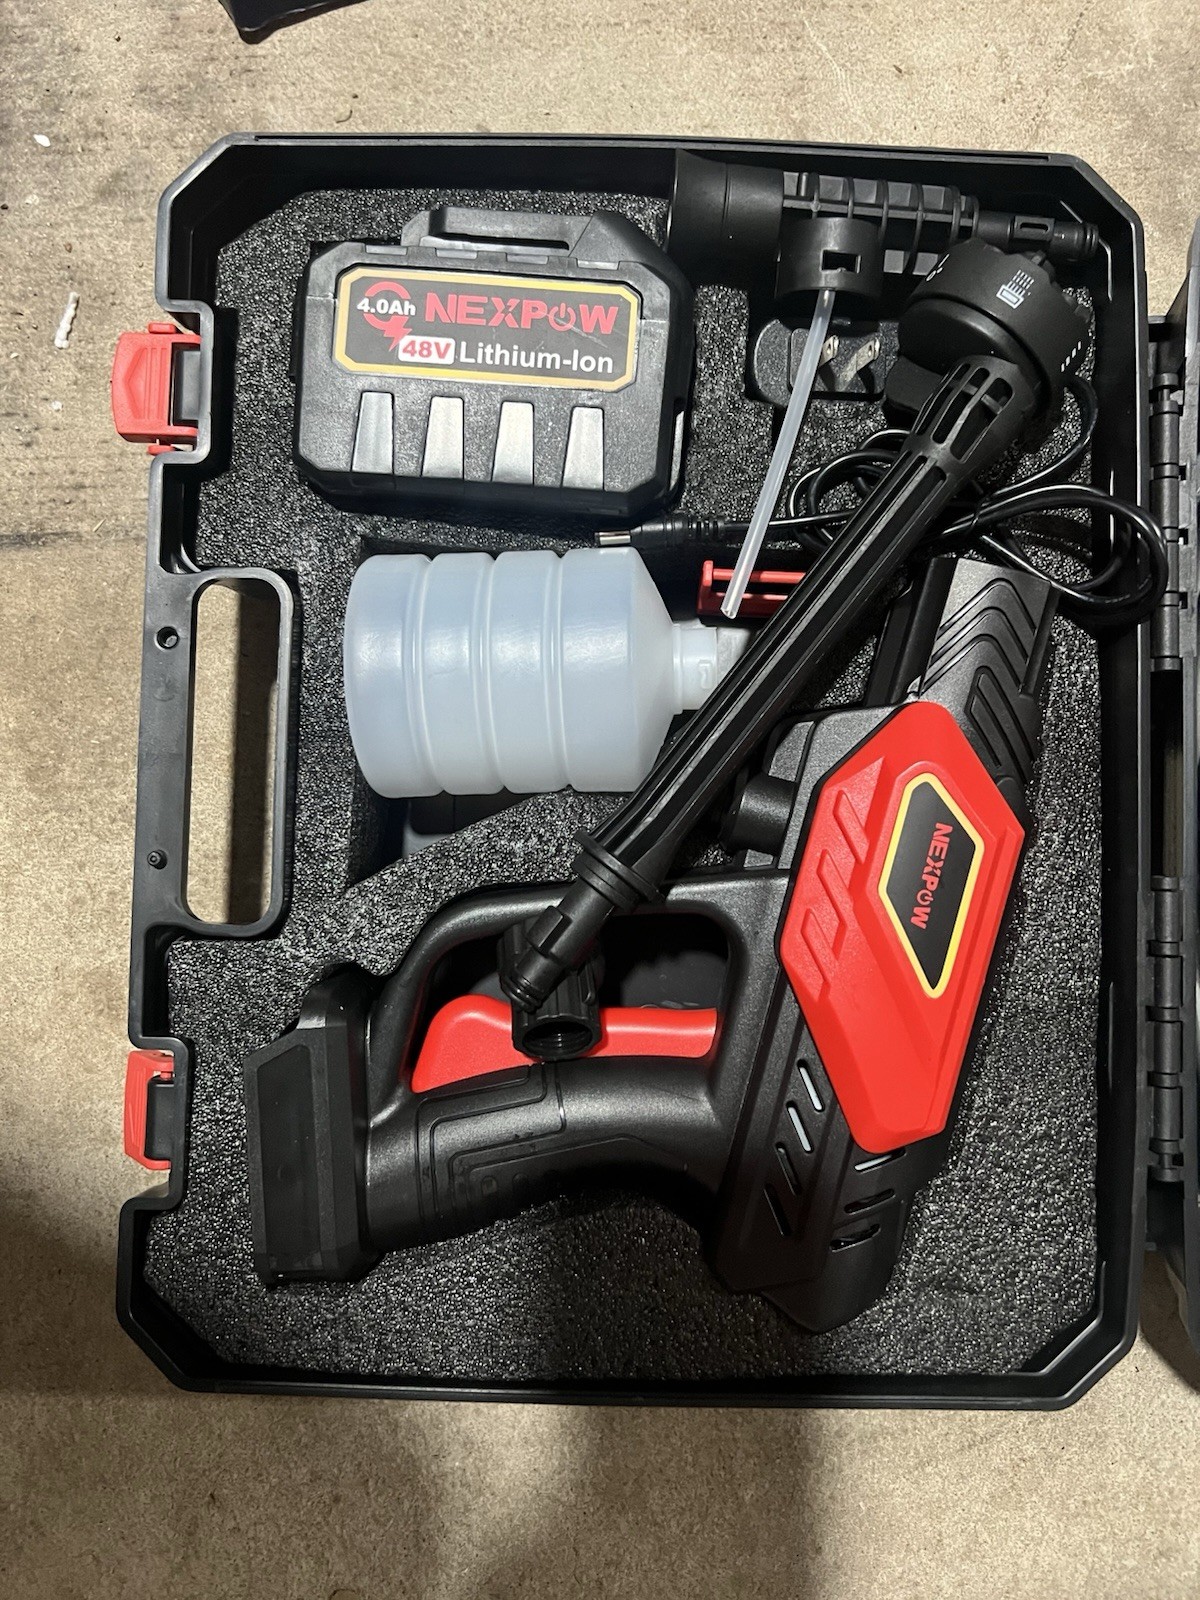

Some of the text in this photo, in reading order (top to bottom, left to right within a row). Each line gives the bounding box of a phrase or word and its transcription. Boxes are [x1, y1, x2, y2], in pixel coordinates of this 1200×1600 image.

[356, 297, 416, 316] 4.0Ah
[425, 292, 619, 334] NEXPOW
[402, 339, 613, 374] 48V Lithium-Ion
[910, 822, 953, 930] NEXPOW
